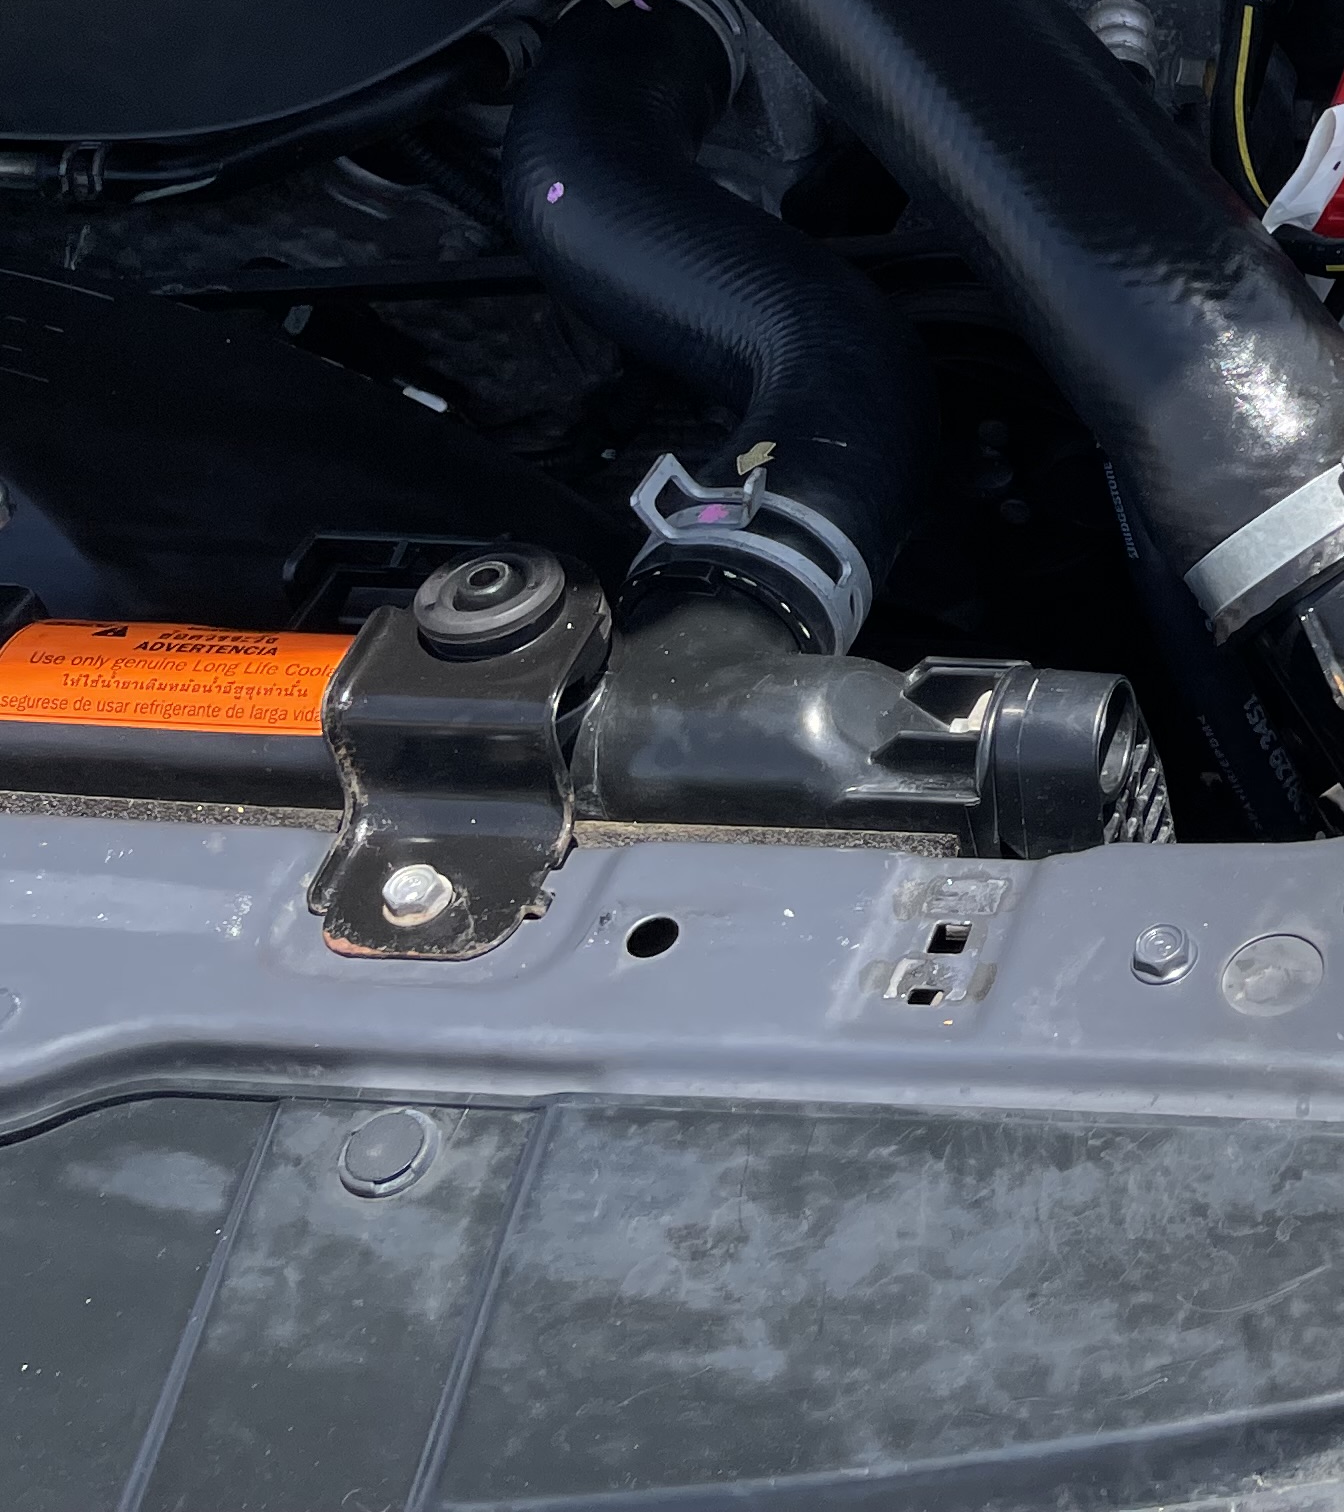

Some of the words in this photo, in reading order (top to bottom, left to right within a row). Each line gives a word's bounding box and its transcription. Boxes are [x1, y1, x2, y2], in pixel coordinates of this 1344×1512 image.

[133, 641, 278, 656] ADVERTENCIA
[29, 650, 66, 665] Use
[71, 654, 111, 670] only
[110, 656, 187, 672] genuine
[192, 659, 240, 676] Long
[244, 661, 279, 676] Life
[285, 663, 335, 678] Coola
[73, 696, 92, 712] de
[96, 700, 130, 714] usar
[133, 697, 221, 720] refrigerante
[226, 704, 244, 719] de
[250, 703, 288, 724] larga
[293, 705, 321, 722] vida
